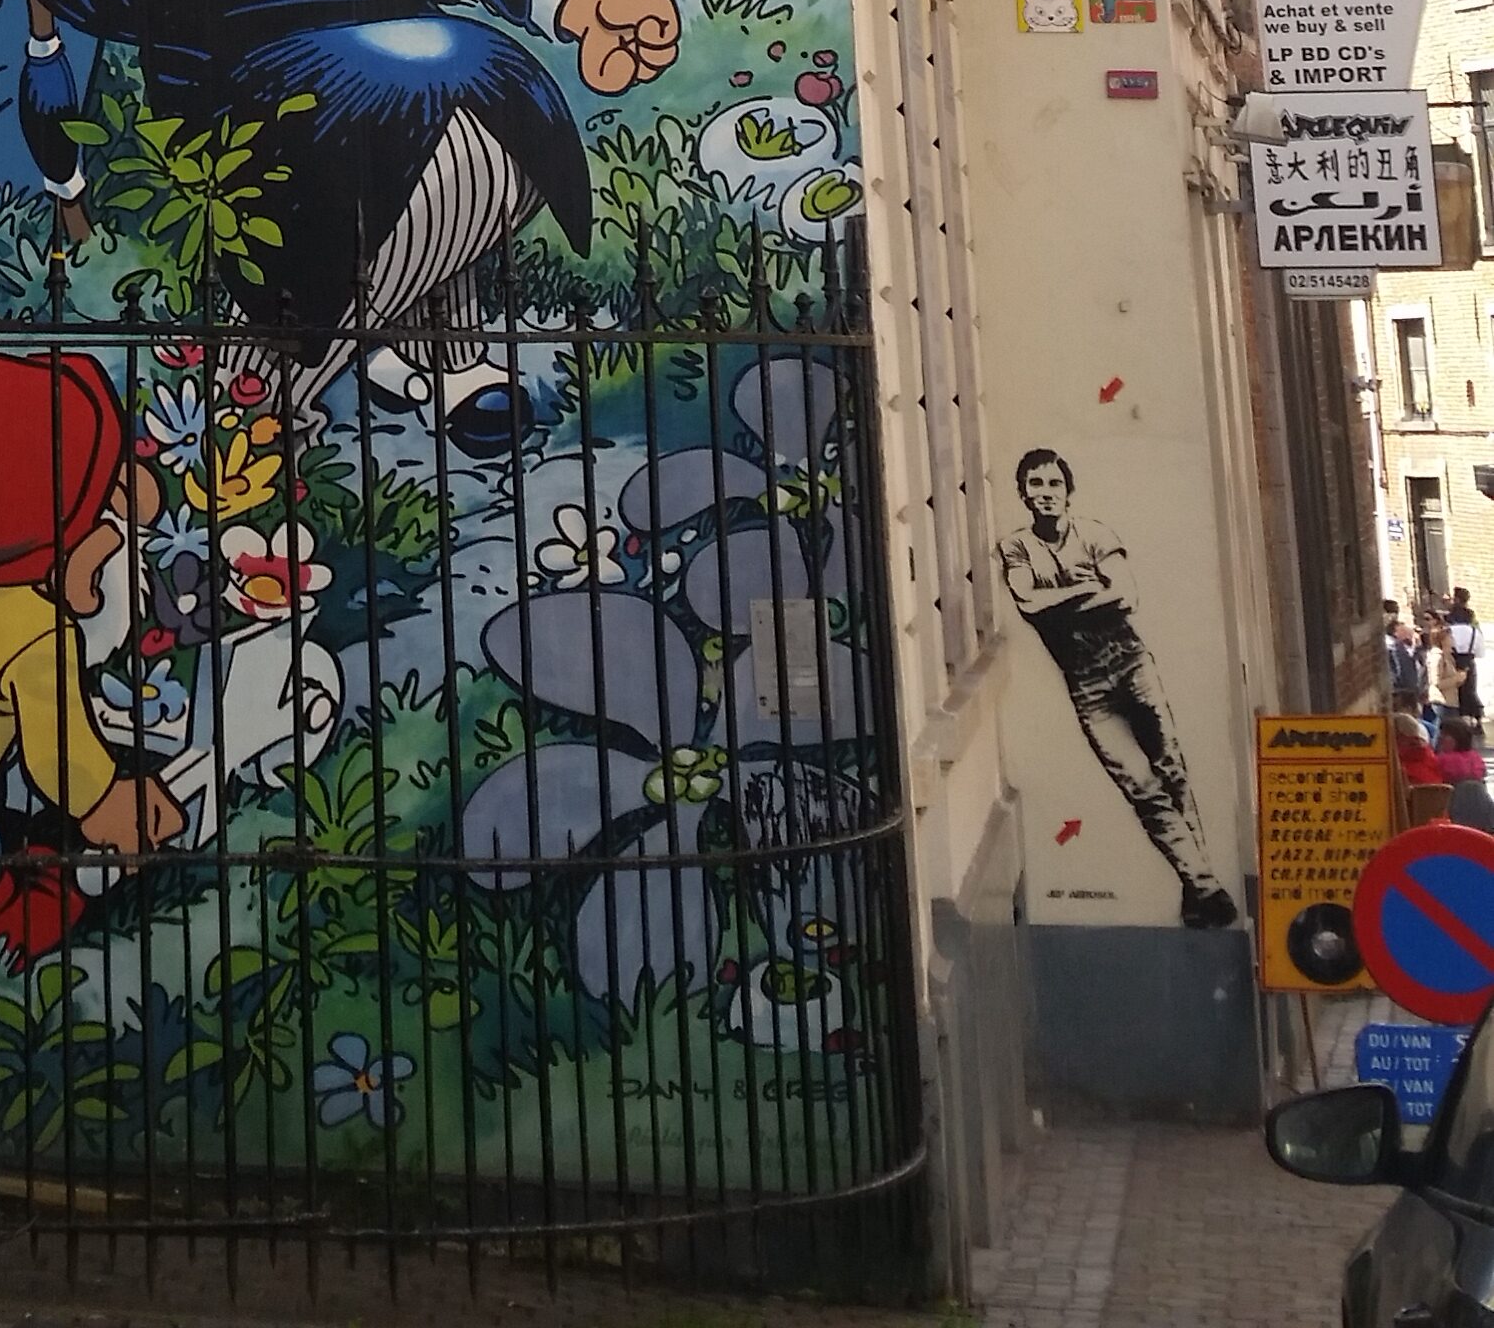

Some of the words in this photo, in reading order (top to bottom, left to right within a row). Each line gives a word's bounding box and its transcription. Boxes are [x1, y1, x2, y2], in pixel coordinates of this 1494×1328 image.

[1264, 4, 1315, 18] Achat
[1321, 4, 1339, 17] et
[1344, 3, 1394, 16] vente
[1264, 24, 1290, 34] we
[1296, 20, 1327, 36] buy
[1334, 19, 1347, 32] &
[1354, 18, 1386, 32] sell
[1267, 48, 1293, 62] LP
[1301, 47, 1331, 62] BD
[1338, 46, 1386, 60] CD's
[1269, 69, 1286, 85] &
[1294, 66, 1387, 84] IMPORT
[1274, 224, 1428, 251] АРЛЕКИН
[1269, 768, 1365, 784] secondhand
[1268, 787, 1322, 803] record
[1329, 788, 1368, 806] shop
[1271, 884, 1302, 900] and
[1404, 1057, 1431, 1072] TOT
[1403, 1080, 1434, 1094] VAN
[1407, 1102, 1434, 1117] TOT
